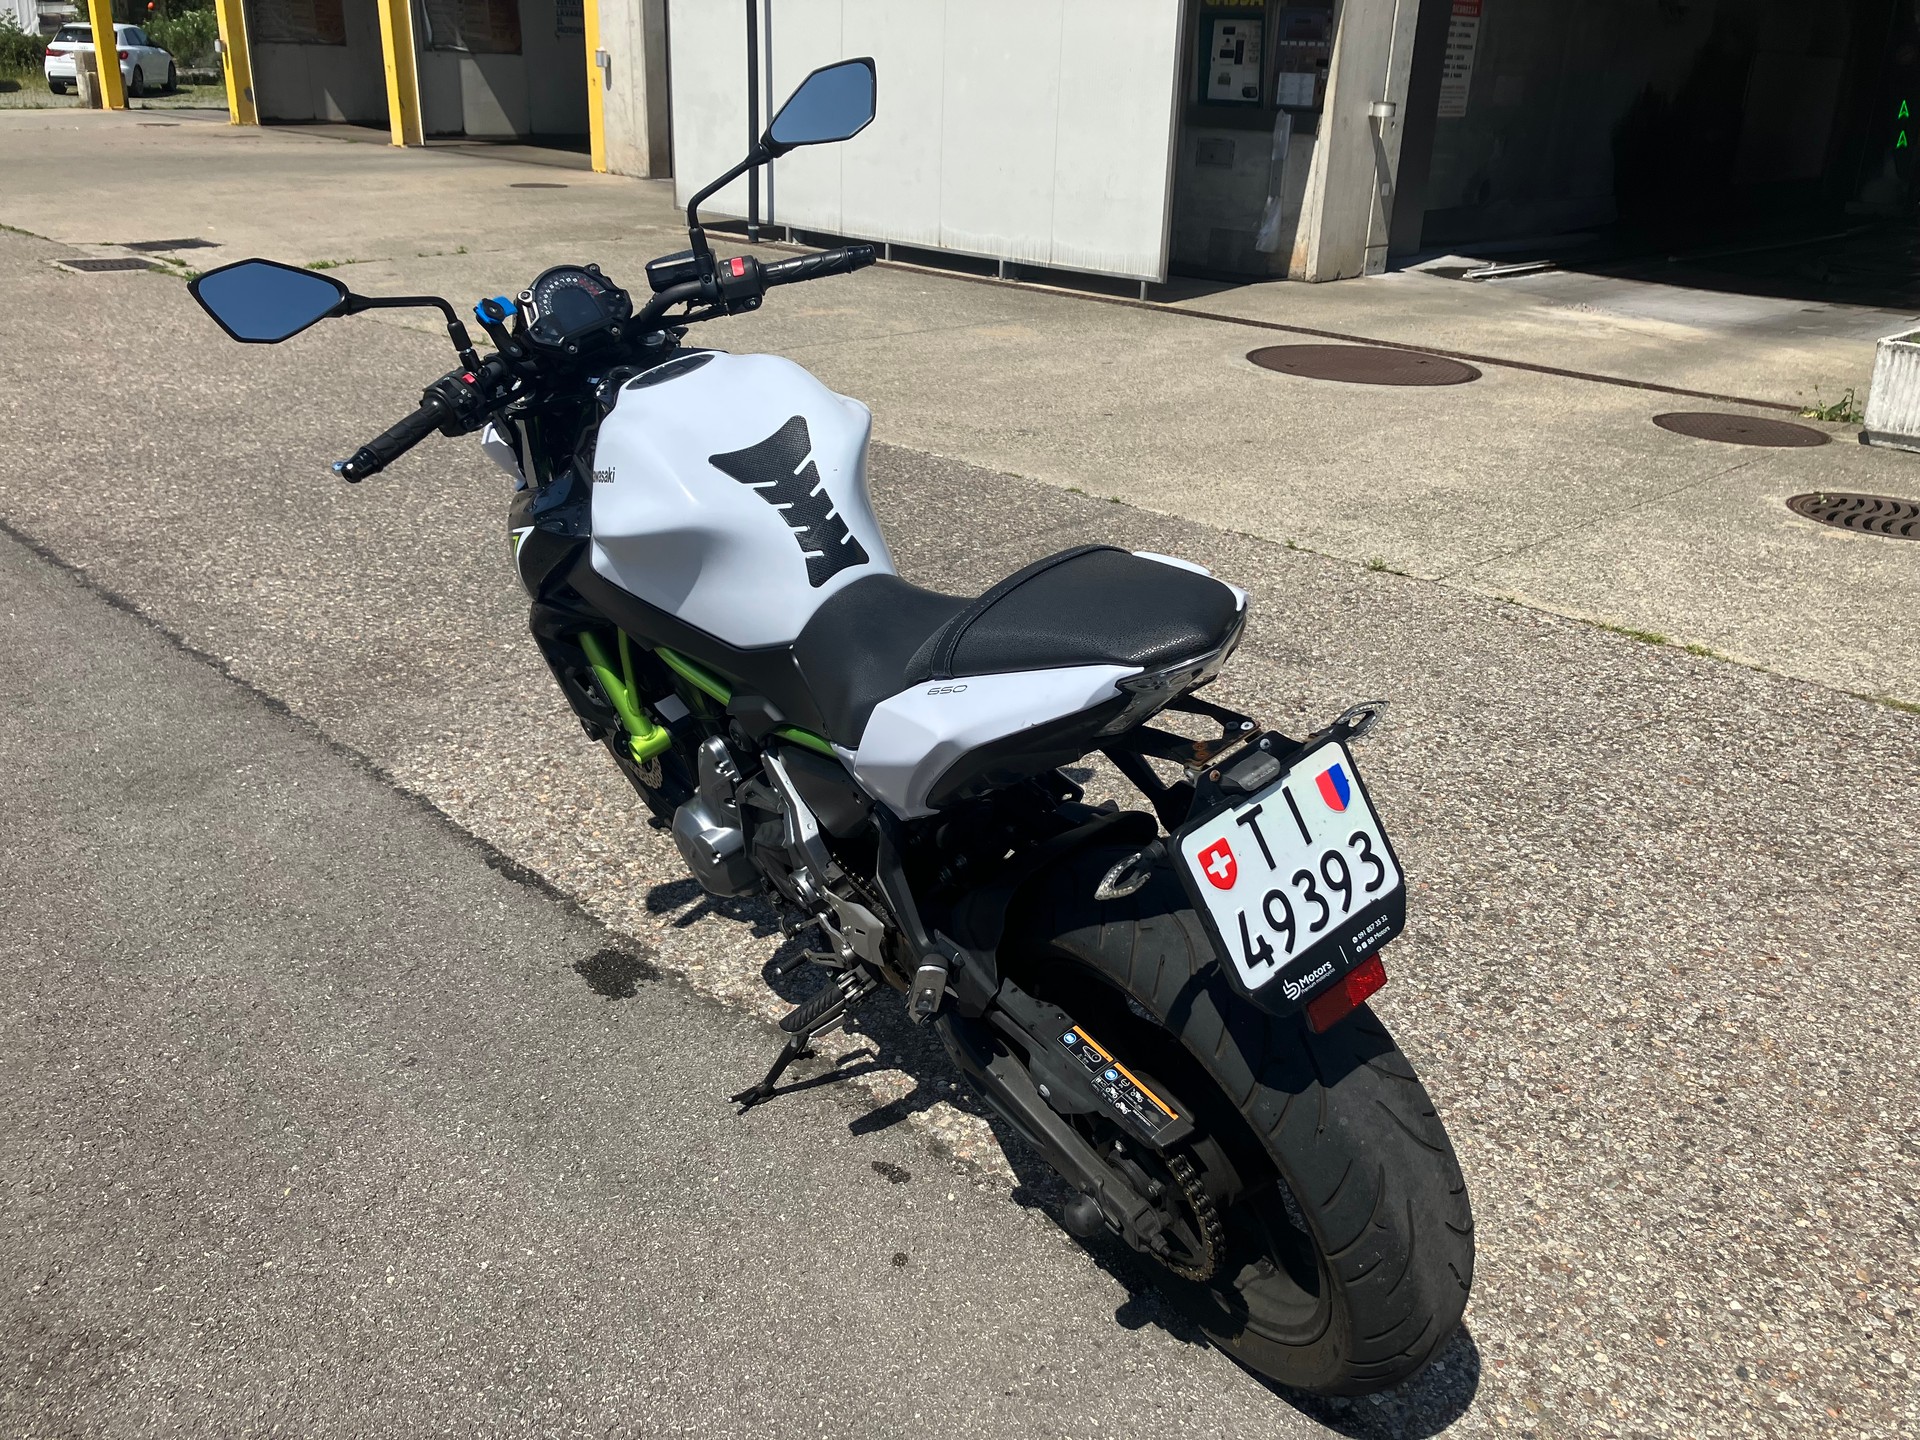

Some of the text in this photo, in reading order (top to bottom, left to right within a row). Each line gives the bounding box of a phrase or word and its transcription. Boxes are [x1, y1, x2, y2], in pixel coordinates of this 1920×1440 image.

[927, 684, 968, 695] 650
[1237, 830, 1386, 970] 49393
[1298, 961, 1332, 989] Motors
